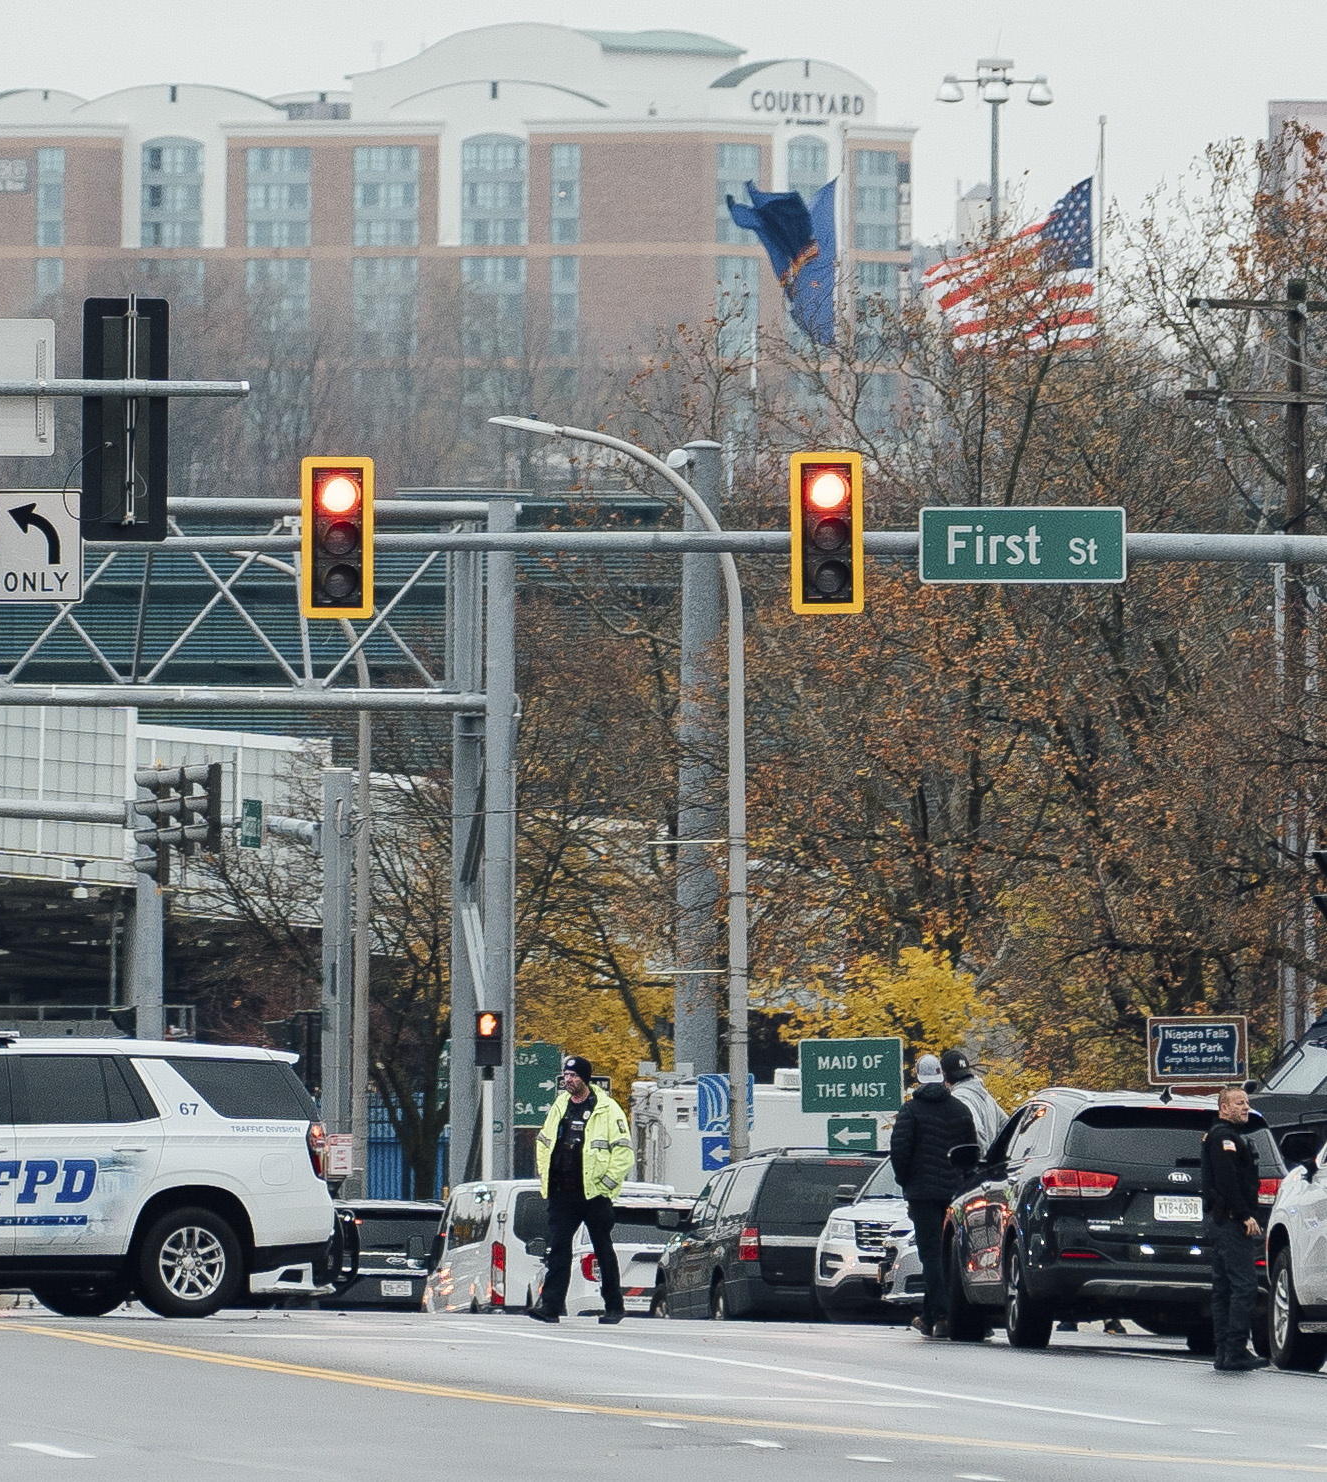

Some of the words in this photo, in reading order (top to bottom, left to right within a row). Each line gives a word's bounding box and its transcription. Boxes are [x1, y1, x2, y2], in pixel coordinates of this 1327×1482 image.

[751, 89, 865, 115] COURTYARD
[947, 525, 1041, 565] First
[1068, 537, 1098, 565] St
[4, 571, 69, 592] ONLY
[1164, 1029, 1203, 1041] Niagara
[1205, 1028, 1230, 1039] Falls
[1171, 1043, 1198, 1054] State
[1199, 1043, 1224, 1053] Park
[817, 1055, 858, 1070] MAID
[862, 1054, 884, 1069] OF
[816, 1083, 847, 1098] THE
[851, 1082, 887, 1098] MIST
[179, 1103, 200, 1116] 67
[1172, 1174, 1189, 1182] KIA
[58, 1216, 83, 1224] NY
